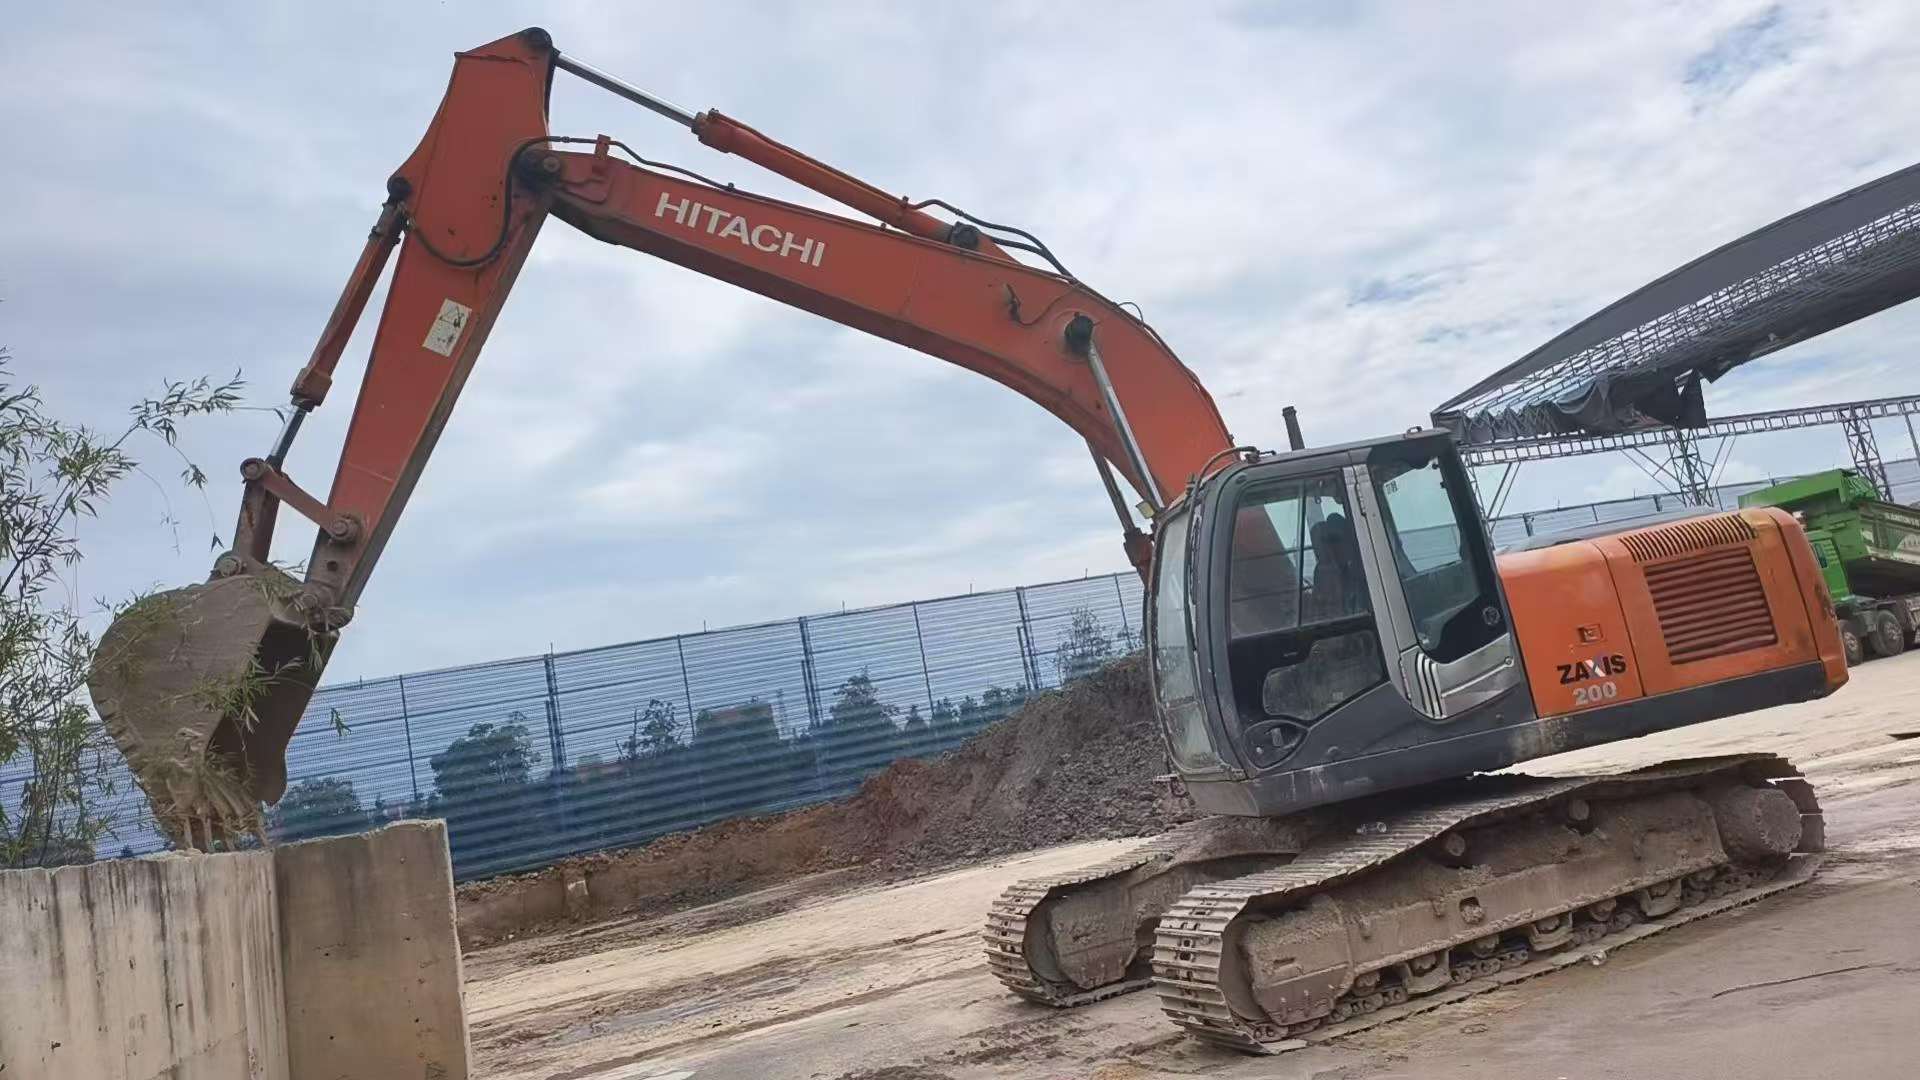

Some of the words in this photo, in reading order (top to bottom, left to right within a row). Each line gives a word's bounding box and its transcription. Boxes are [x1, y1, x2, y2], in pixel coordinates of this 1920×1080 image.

[655, 192, 825, 267] HITACHI
[1557, 654, 1627, 684] ZAXIS
[1573, 681, 1617, 706] 200
